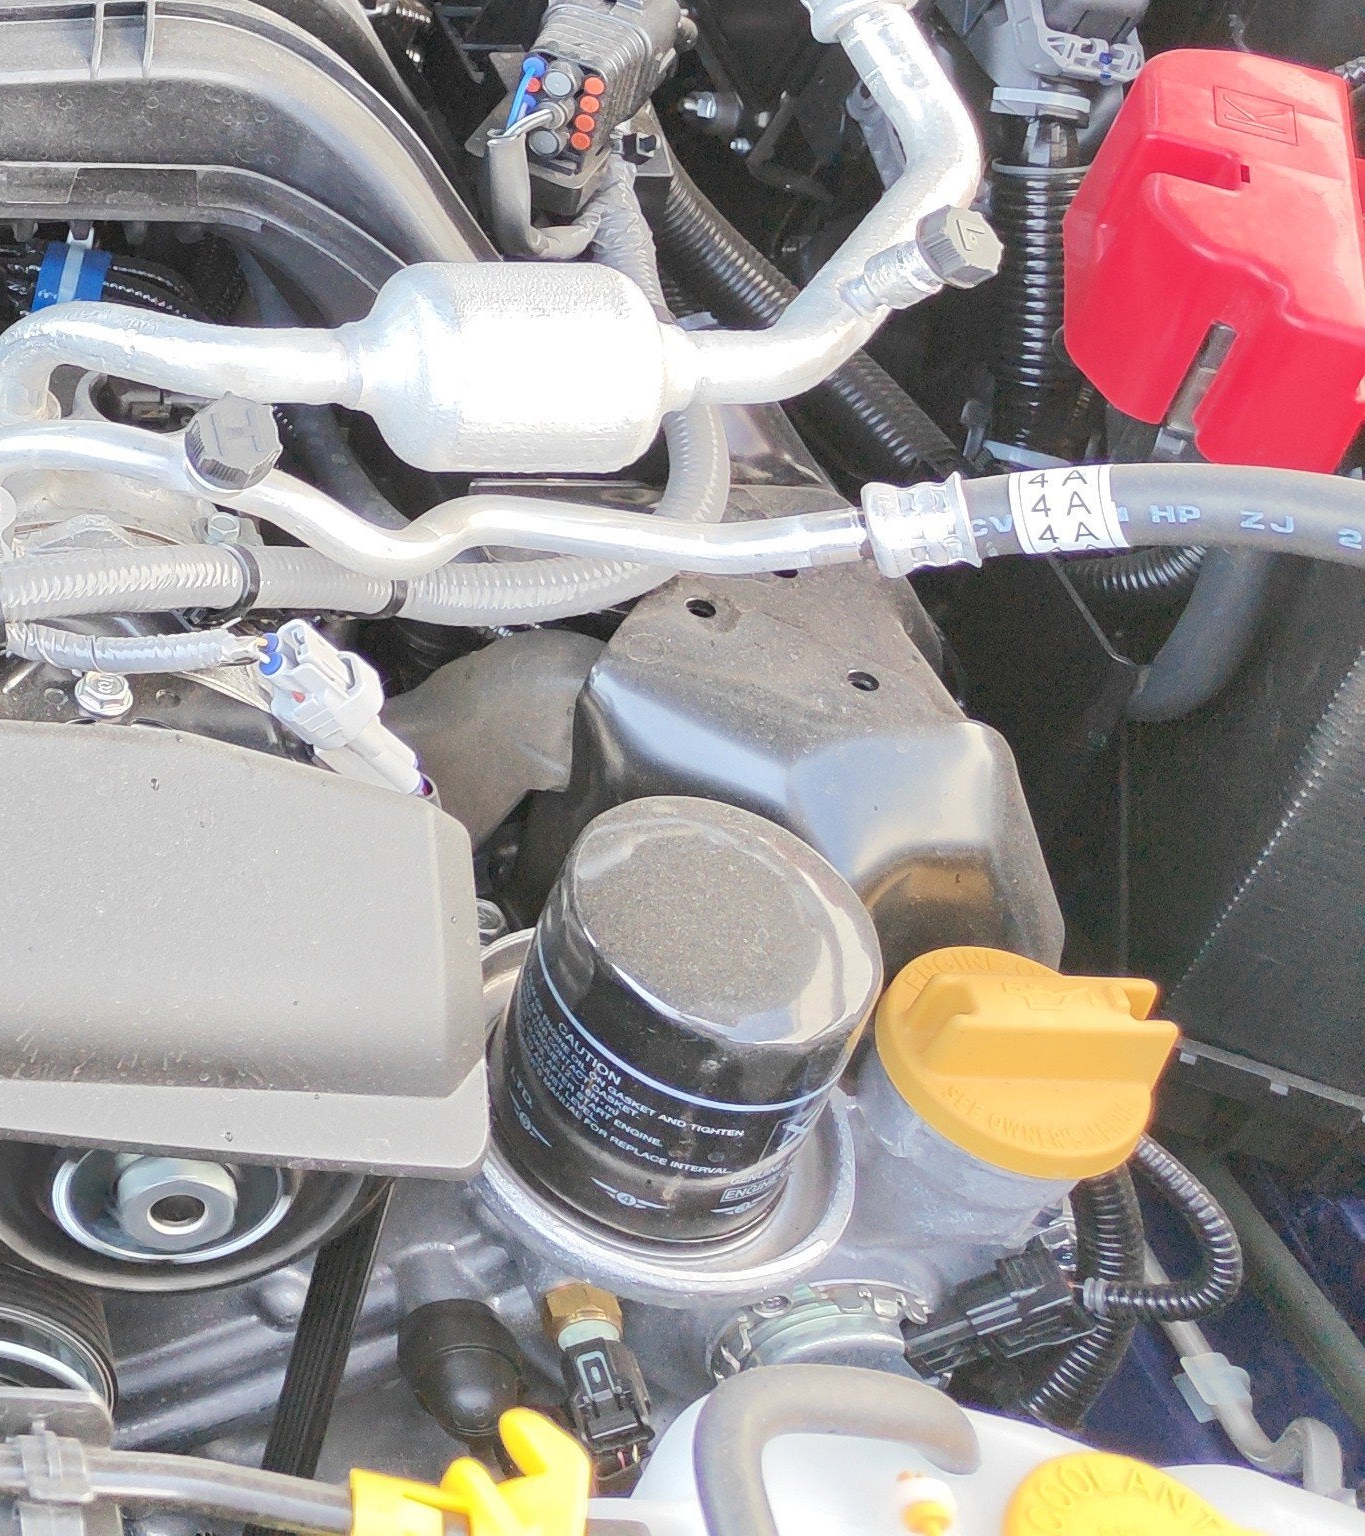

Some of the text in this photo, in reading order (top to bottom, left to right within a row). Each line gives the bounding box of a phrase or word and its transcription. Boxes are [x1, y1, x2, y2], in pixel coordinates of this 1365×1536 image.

[1027, 469, 1088, 489] 4 A
[1031, 490, 1092, 518] 4 A
[1149, 504, 1202, 524] HP
[1038, 521, 1101, 543] 4 A
[558, 1022, 621, 1085] CAUTION
[570, 1053, 586, 1071] OIL
[589, 1070, 606, 1088] ON
[607, 1085, 657, 1117] GASKET
[658, 1113, 687, 1129] AND
[690, 1122, 745, 1138] TIGHTEN
[574, 1089, 612, 1122] START
[582, 1116, 608, 1138] FOR
[609, 1135, 668, 1166] REPLACE
